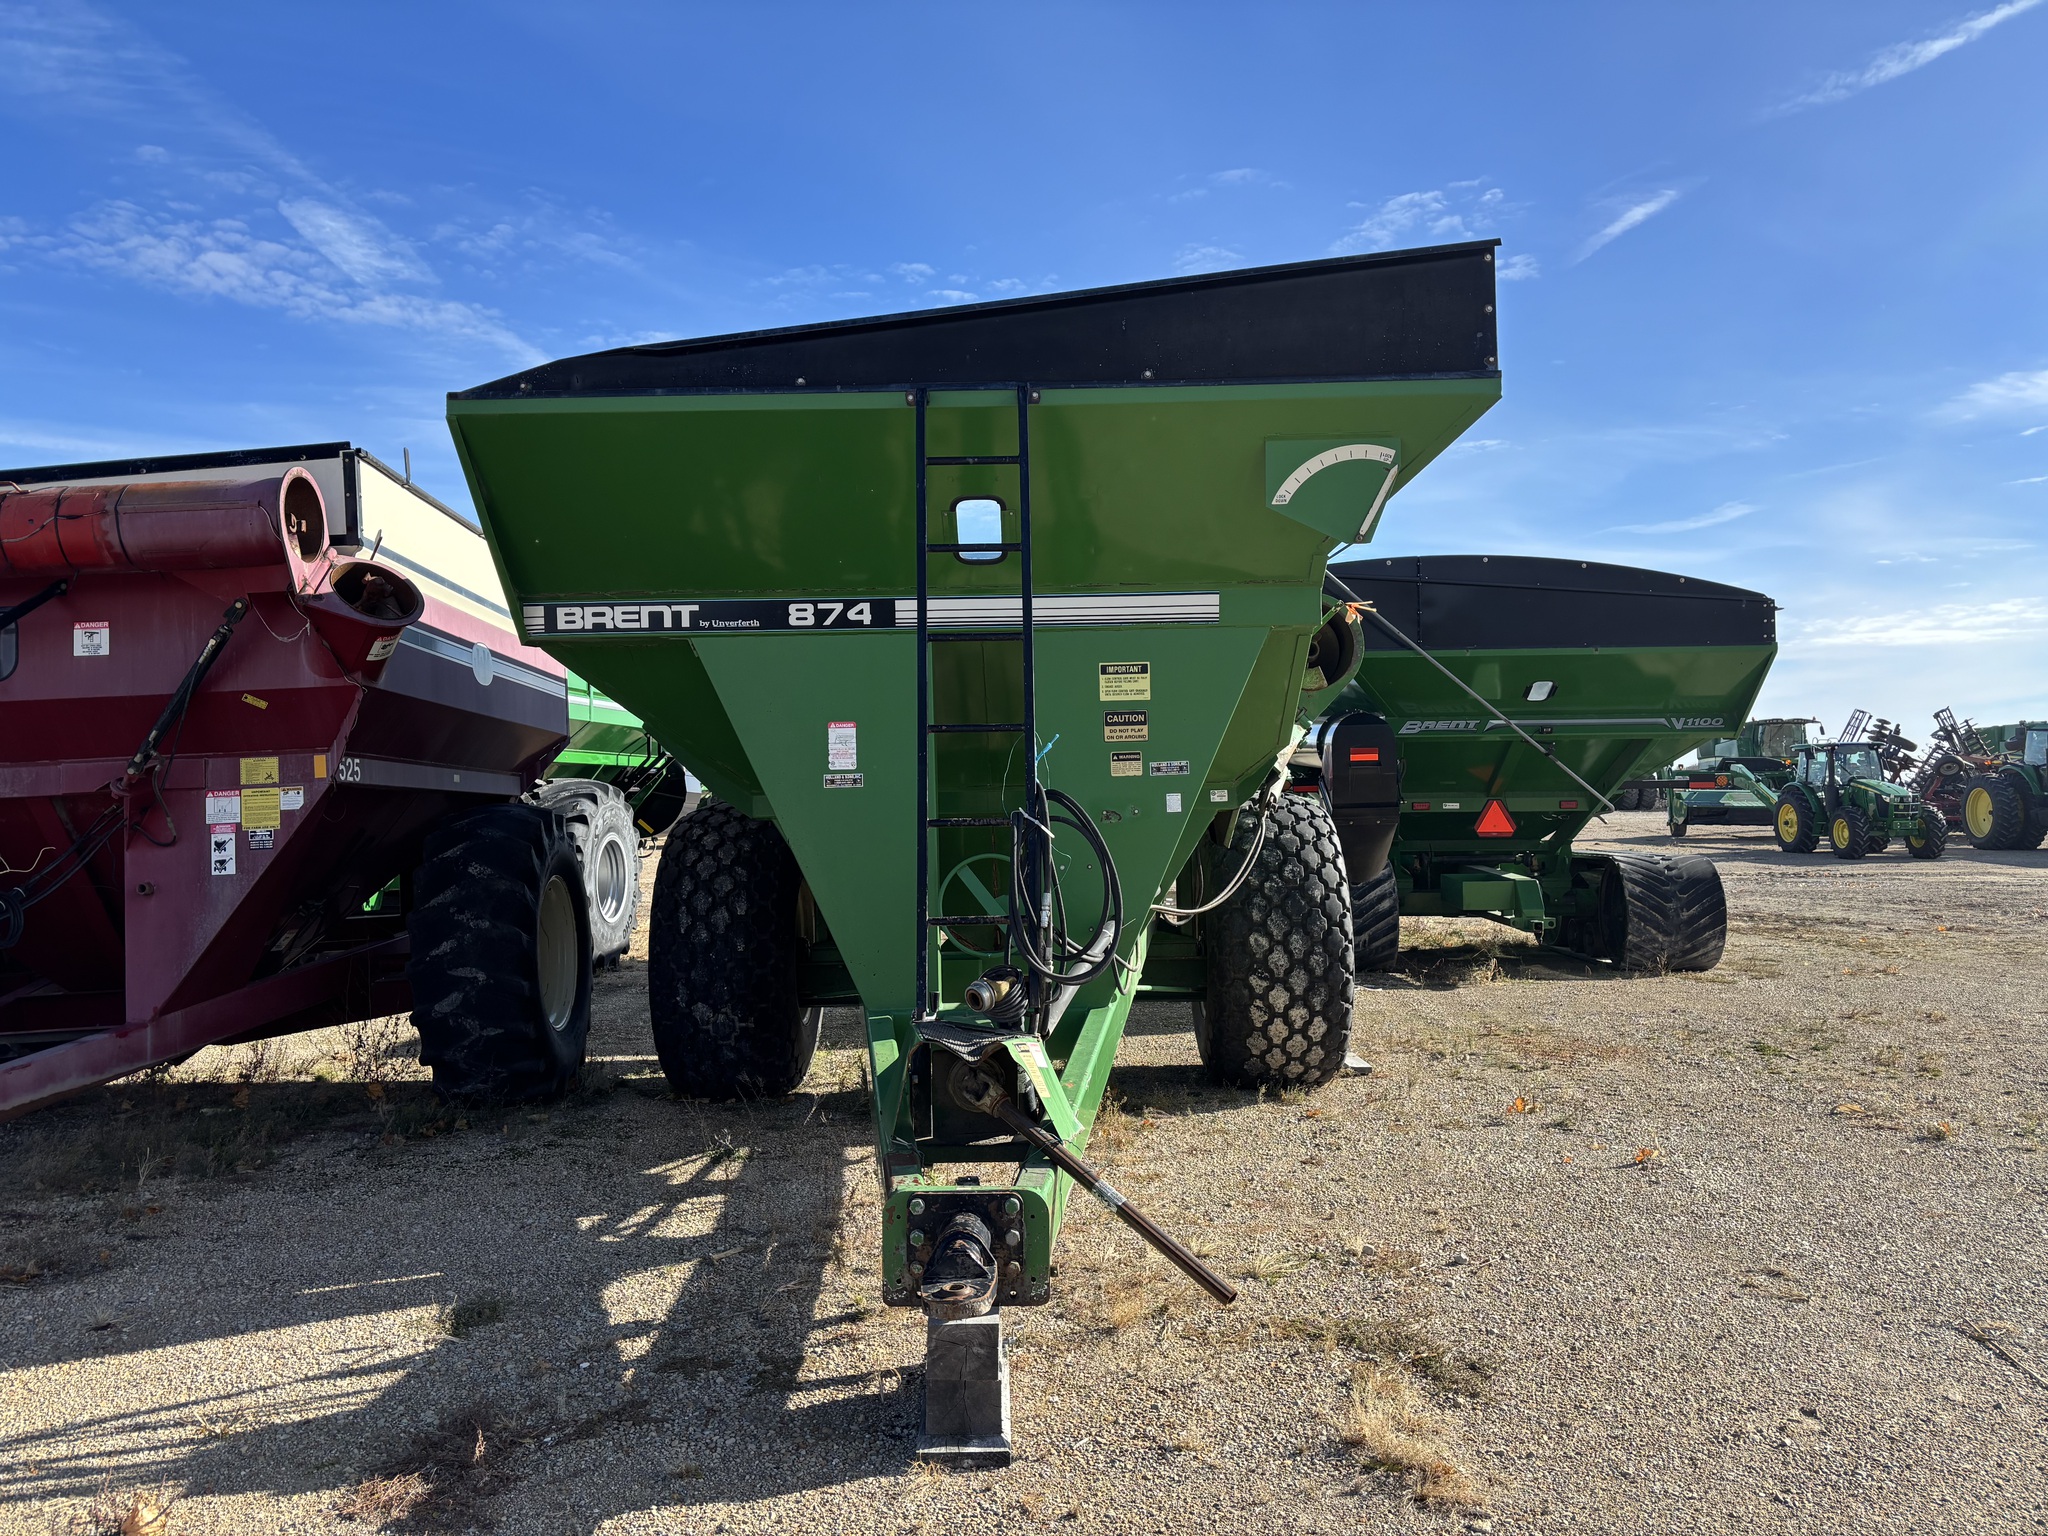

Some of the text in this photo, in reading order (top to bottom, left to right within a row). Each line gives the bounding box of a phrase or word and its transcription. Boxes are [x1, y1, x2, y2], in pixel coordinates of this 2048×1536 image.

[556, 604, 700, 630] BRENT
[788, 602, 872, 626] 874
[699, 618, 760, 628] by Unverferth
[1106, 665, 1142, 673] IMPORTANT
[1107, 714, 1145, 722] CAUTION
[1671, 717, 1725, 730] V1100
[1398, 720, 1480, 734] BRENT
[339, 757, 361, 781] 525
